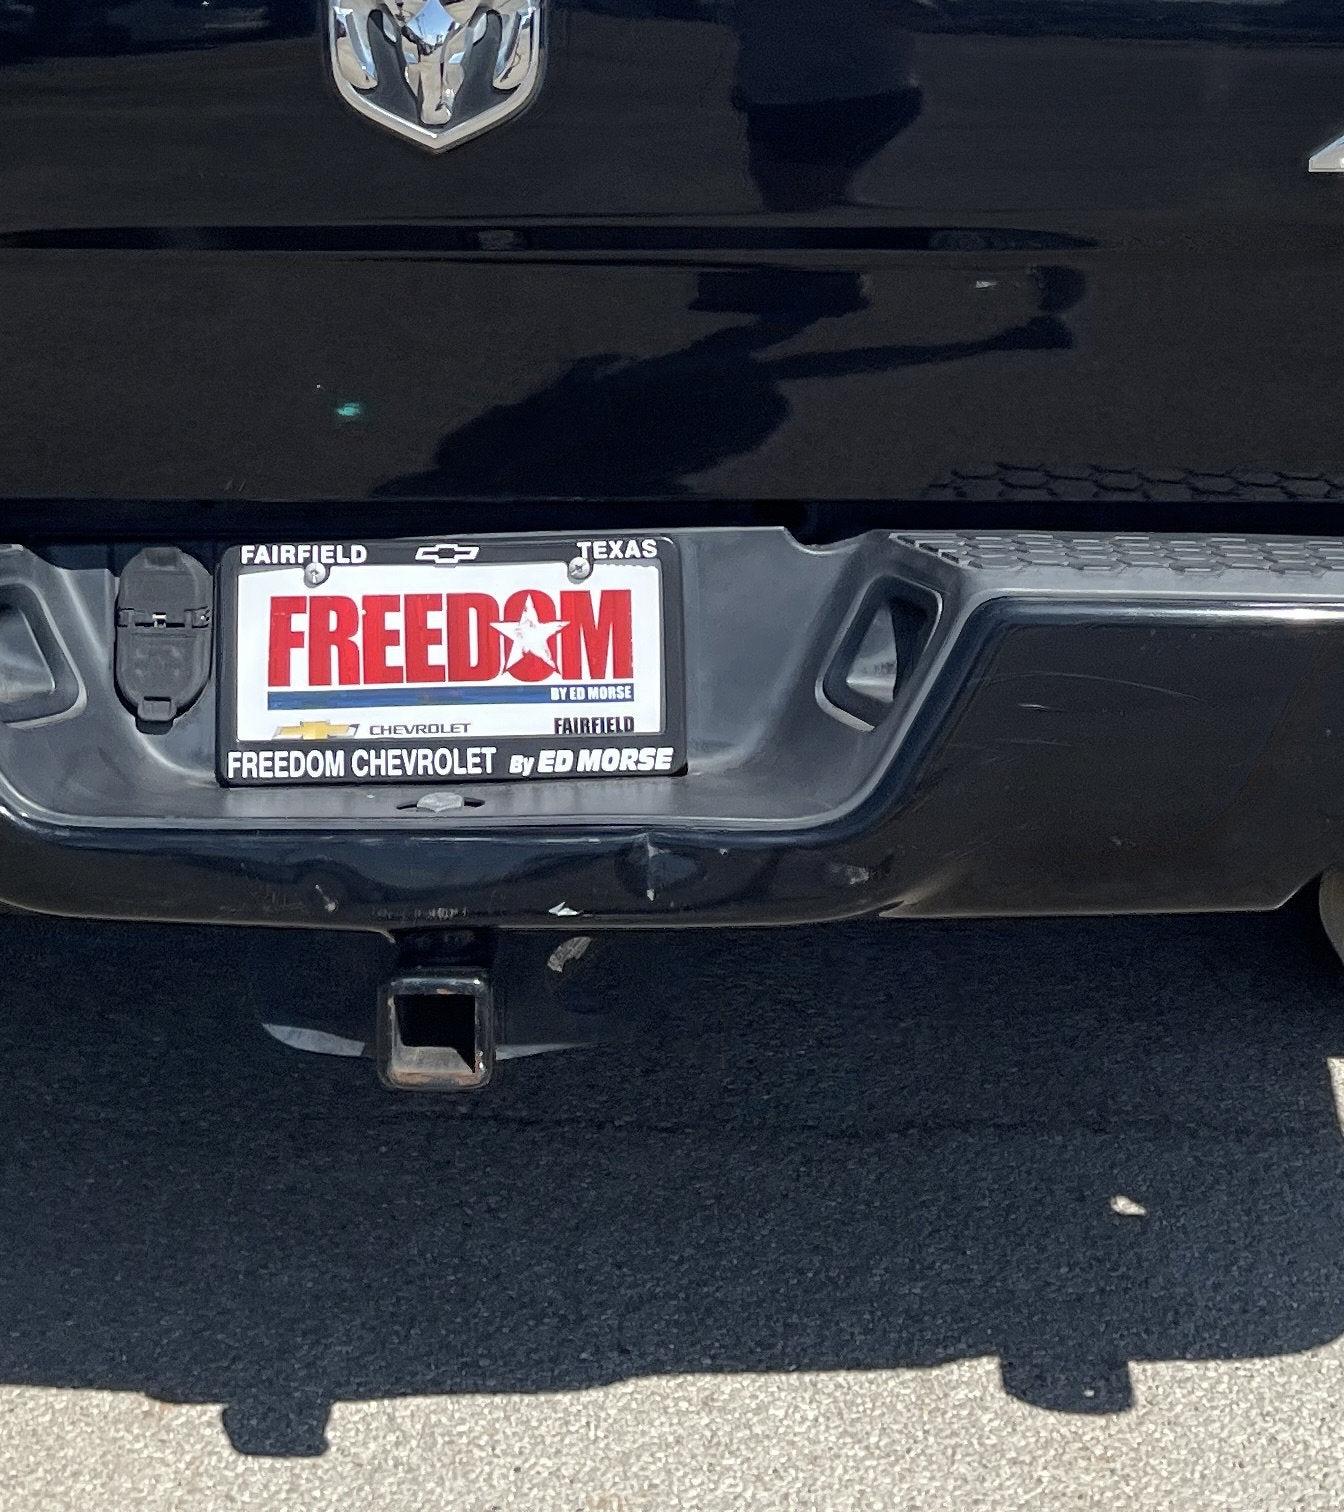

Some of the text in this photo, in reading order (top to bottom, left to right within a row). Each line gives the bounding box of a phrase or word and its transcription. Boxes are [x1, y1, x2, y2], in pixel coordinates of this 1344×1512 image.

[240, 544, 368, 565] FAIRFIELD
[576, 539, 658, 559] TEXAS
[268, 590, 634, 686] FREEDOM
[550, 685, 632, 701] BY ED MORSE
[369, 722, 472, 735] CHEVROLET
[554, 716, 634, 735] FAIRFIELD
[227, 747, 674, 778] FREEDOM CHEVROLET By ED MORSE
